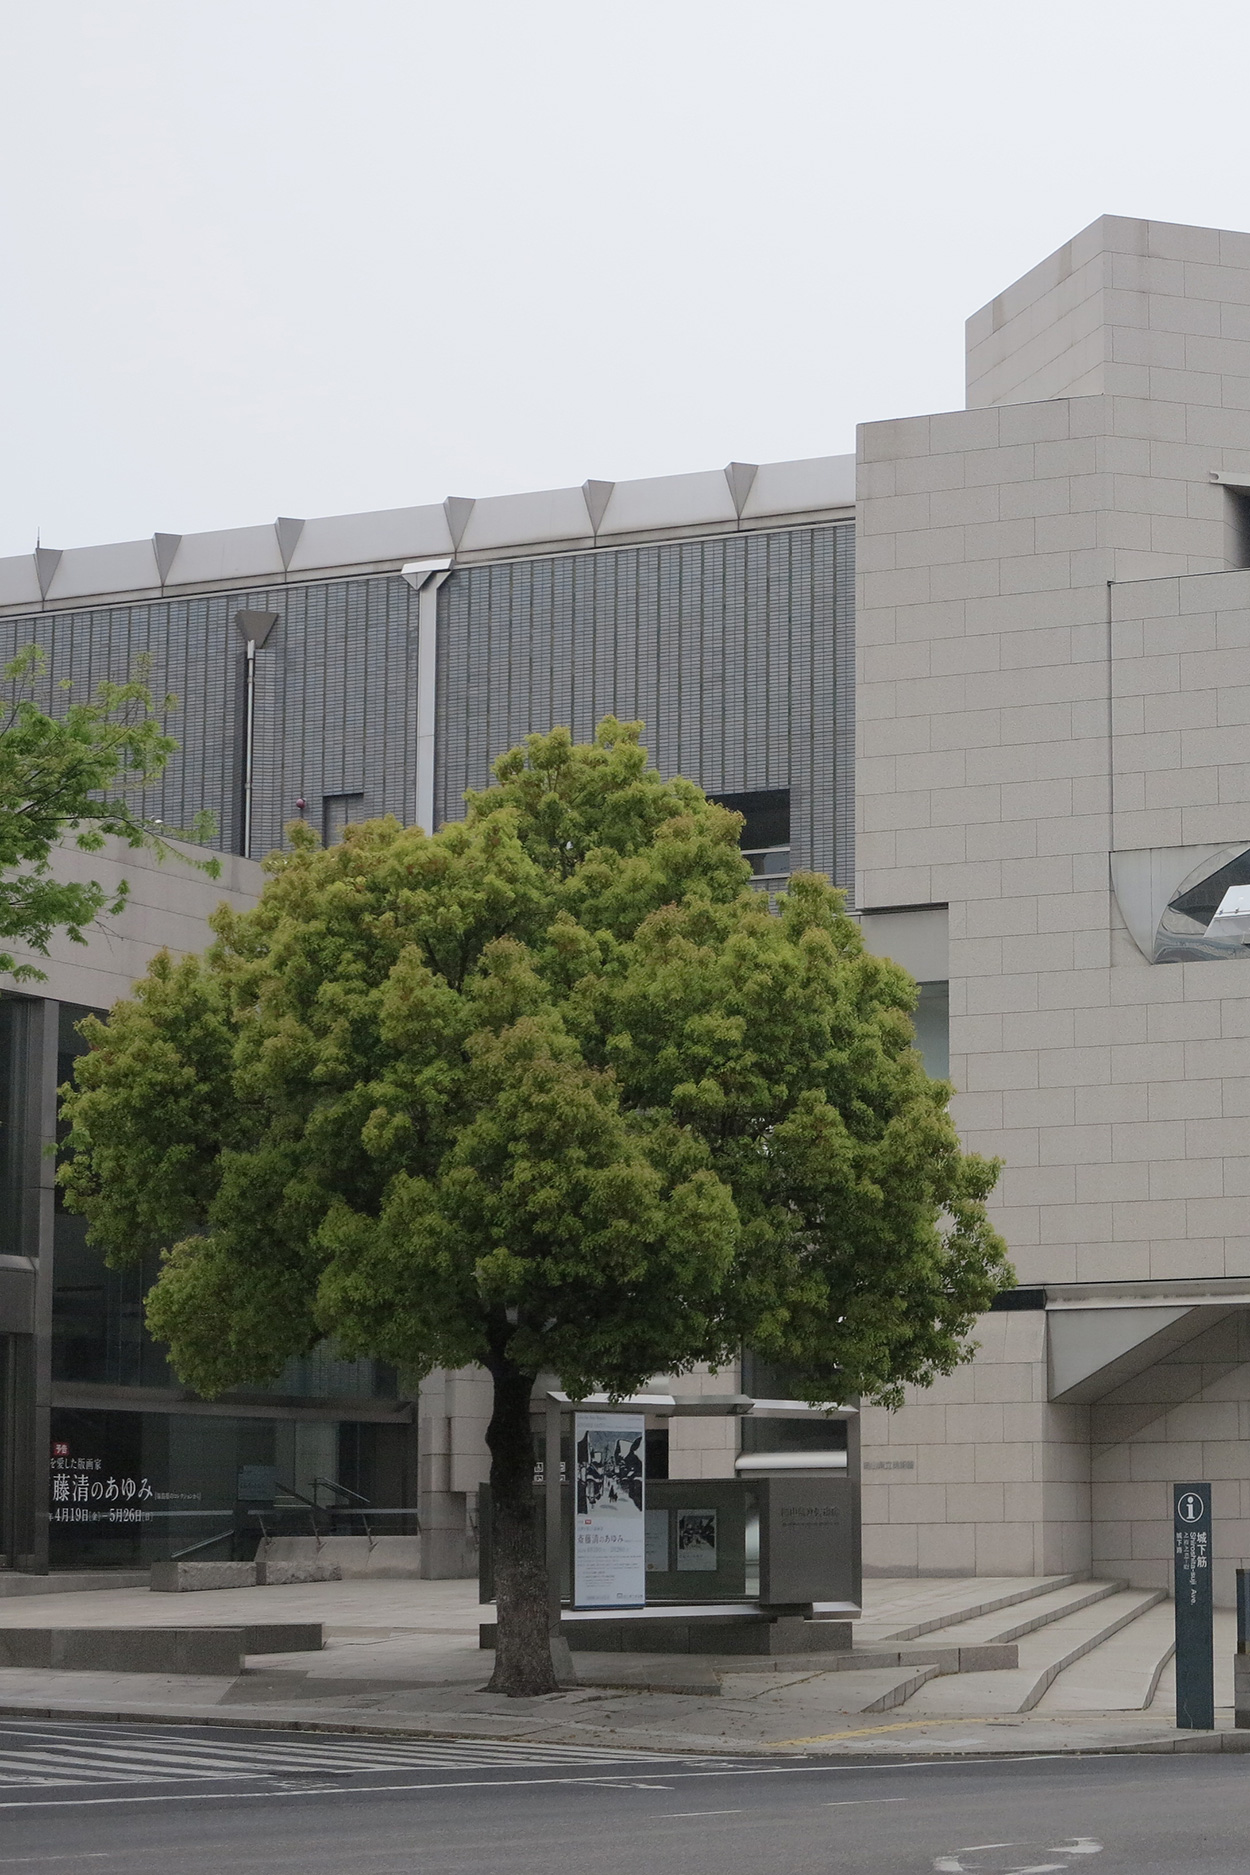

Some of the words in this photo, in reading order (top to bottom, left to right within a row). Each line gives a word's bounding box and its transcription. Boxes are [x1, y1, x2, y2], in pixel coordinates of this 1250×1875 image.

[56, 1444, 68, 1454] 予告
[50, 1457, 101, 1470] を愛した版画家
[49, 1473, 153, 1501] 藤清のあゆみ
[1197, 1532, 1207, 1568] 城下筋
